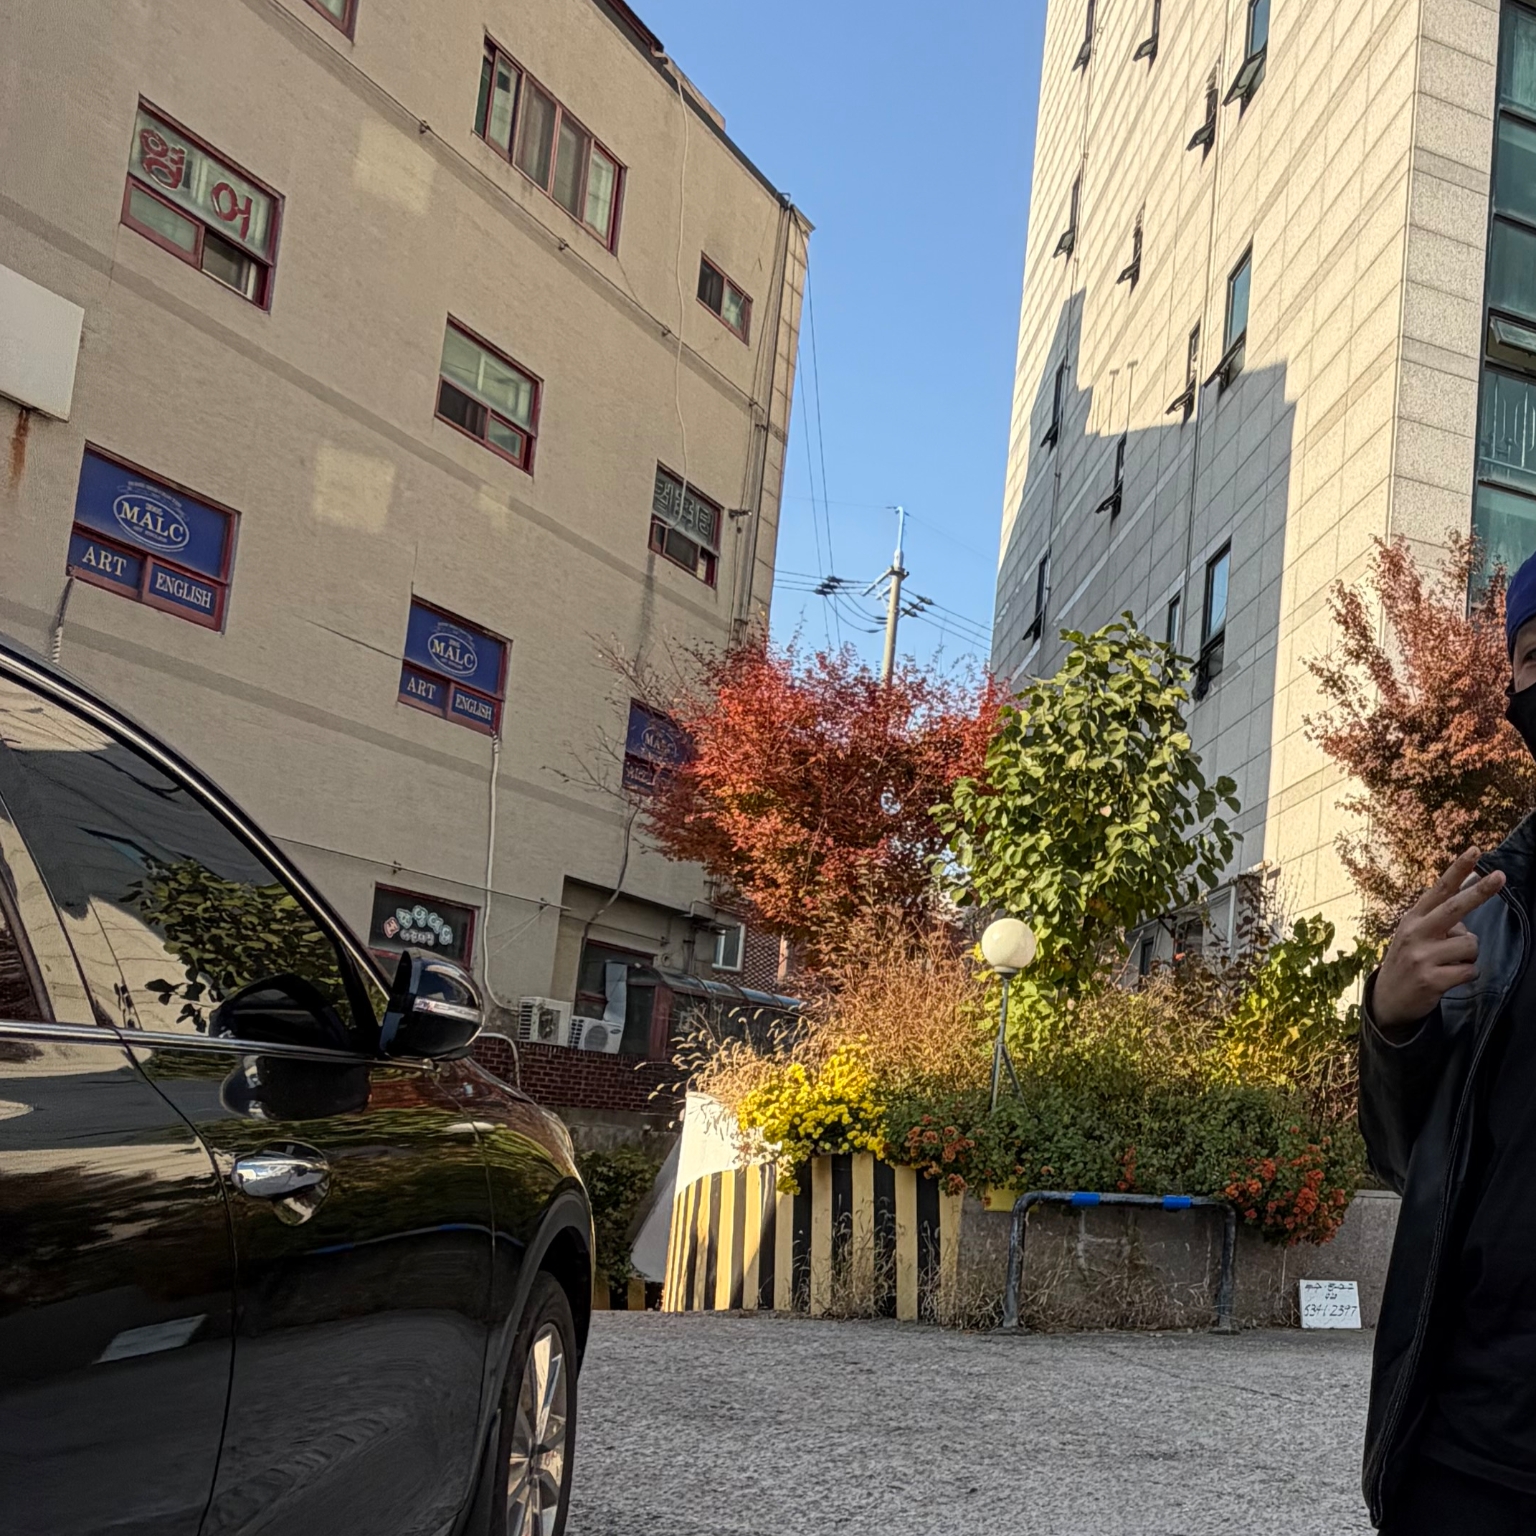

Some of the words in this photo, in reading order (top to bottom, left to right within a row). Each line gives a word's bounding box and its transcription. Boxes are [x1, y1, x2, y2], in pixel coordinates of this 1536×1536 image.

[140, 127, 254, 242] 영어
[119, 500, 185, 543] MALC
[82, 546, 128, 578] ART
[155, 571, 213, 609] ENGLISH
[431, 638, 475, 669] MALC
[406, 677, 437, 700] ART
[455, 693, 493, 721] ENGLISH
